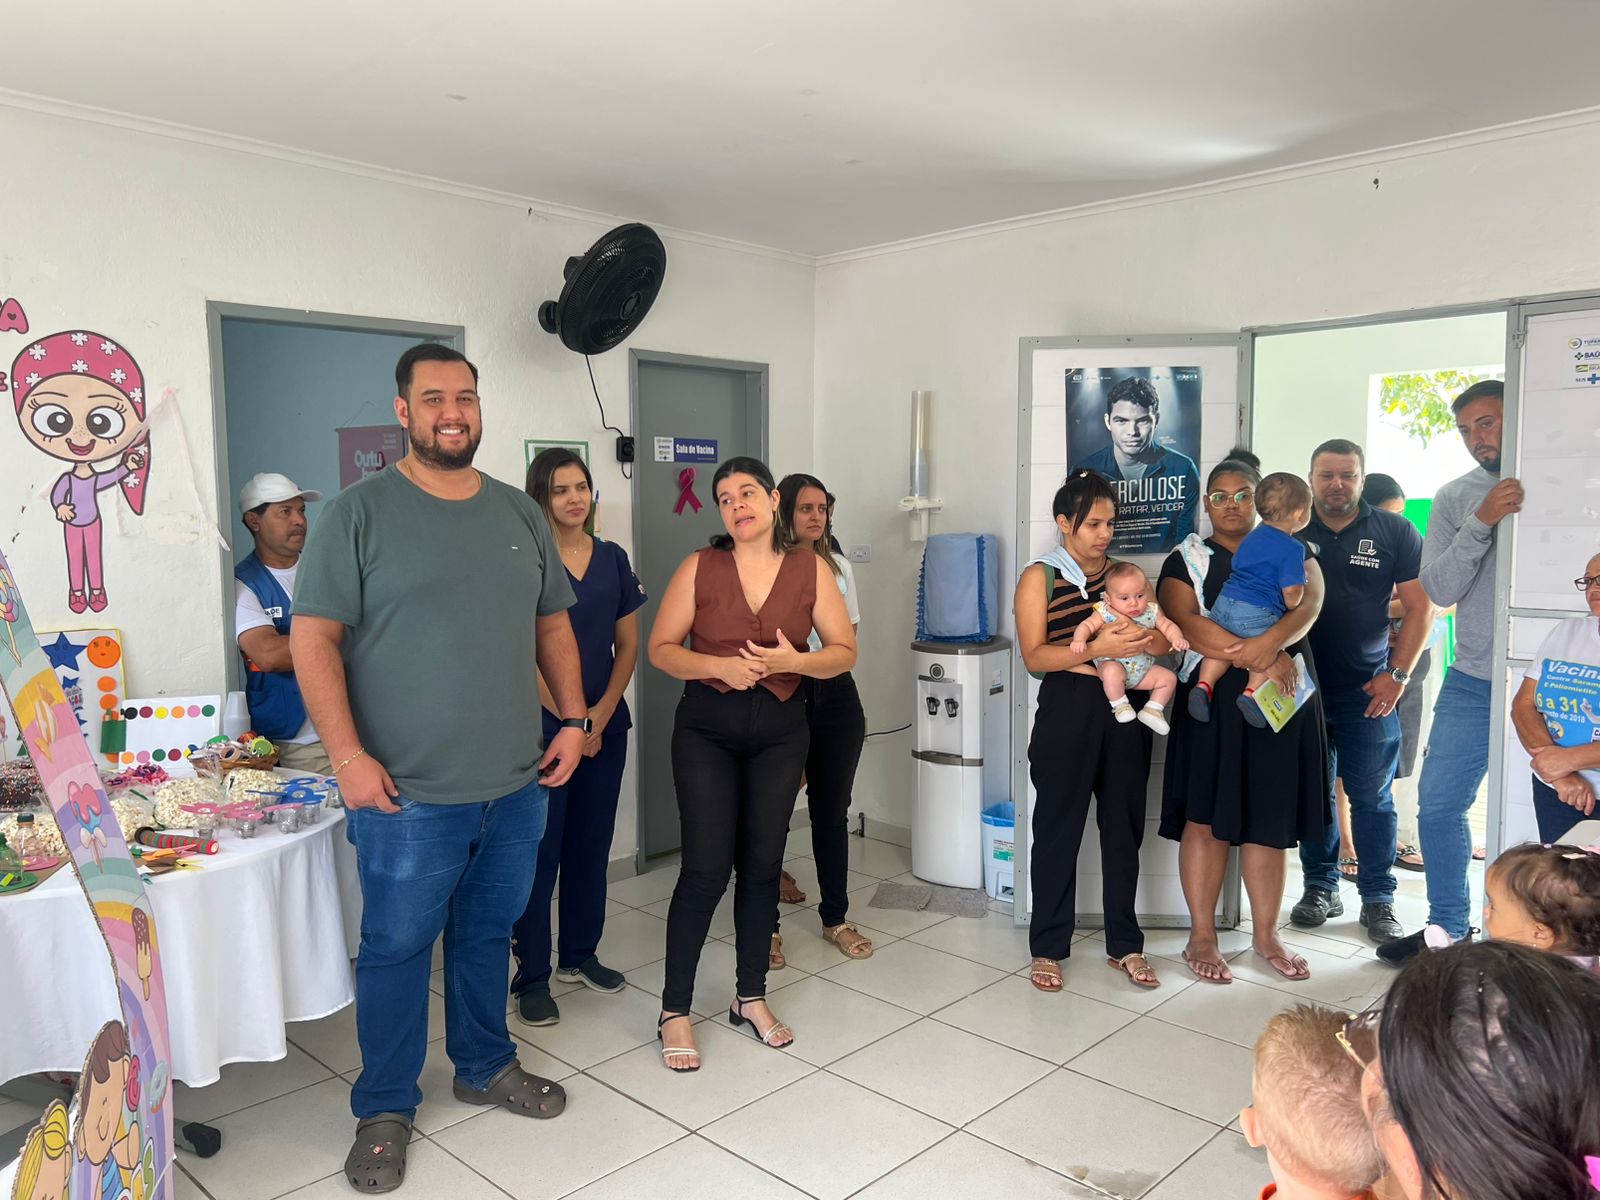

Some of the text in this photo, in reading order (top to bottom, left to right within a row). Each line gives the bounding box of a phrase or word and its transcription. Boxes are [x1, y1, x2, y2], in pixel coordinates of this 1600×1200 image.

[676, 443, 715, 455] Sala de Vacina
[1110, 475, 1186, 504] RCULOSE
[1151, 502, 1185, 513] VENCER
[1349, 559, 1380, 569] AGENTE
[1545, 697, 1556, 709] a
[1559, 696, 1578, 714] 31
[1559, 712, 1568, 720] de
